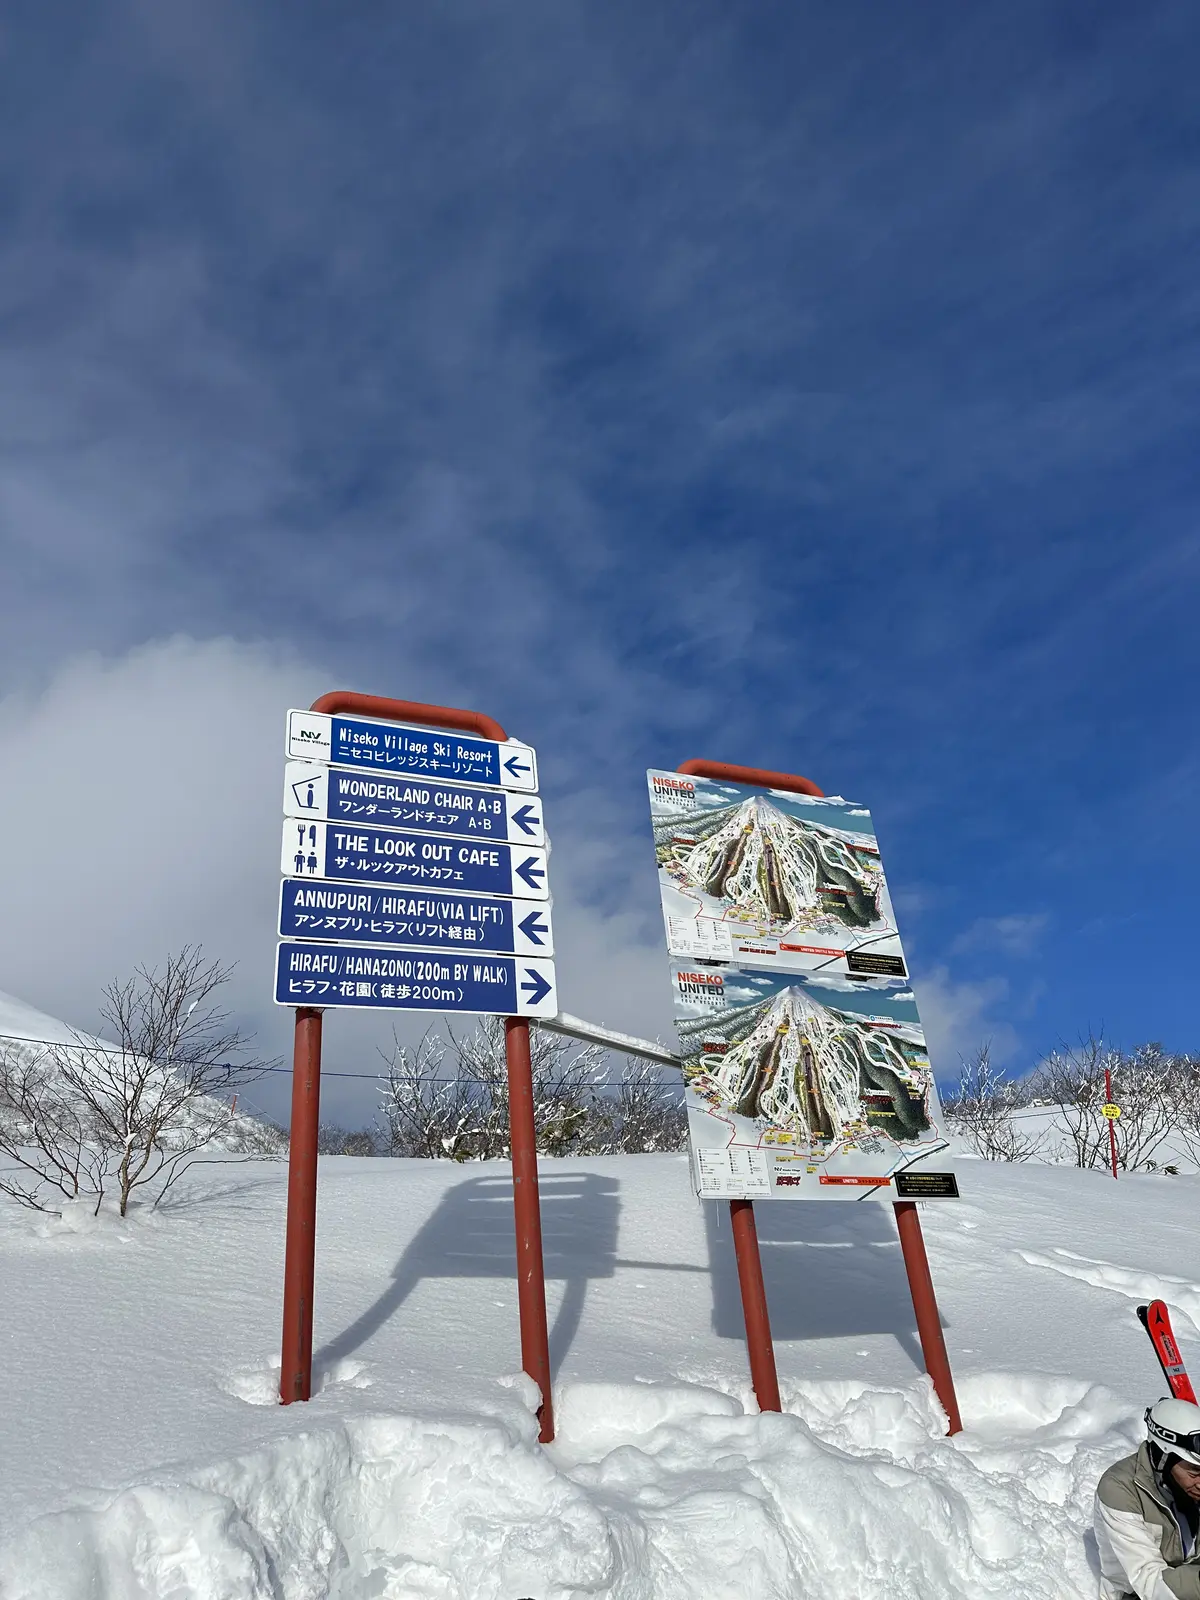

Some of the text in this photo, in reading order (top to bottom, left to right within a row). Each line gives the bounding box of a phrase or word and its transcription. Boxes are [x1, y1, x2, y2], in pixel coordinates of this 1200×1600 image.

[339, 727, 493, 763] Niseko Village Ski Resort
[338, 746, 493, 777] ニセコビレッジスキーリゾート
[339, 778, 430, 806] WONDERLAND
[434, 791, 473, 811] CHAIR
[652, 776, 694, 791] NISEKO
[653, 785, 695, 800] UNITED
[339, 800, 459, 825] ワンダーランドチェア
[334, 833, 500, 867] THE LOOK OUT CAFE
[334, 856, 464, 881] ザ・ルックアウトカフェ
[470, 904, 504, 925] LIFT)
[454, 966, 469, 981] BY
[473, 965, 508, 985] WALK)
[677, 972, 723, 985] NISEKO
[679, 982, 724, 996] UNITED
